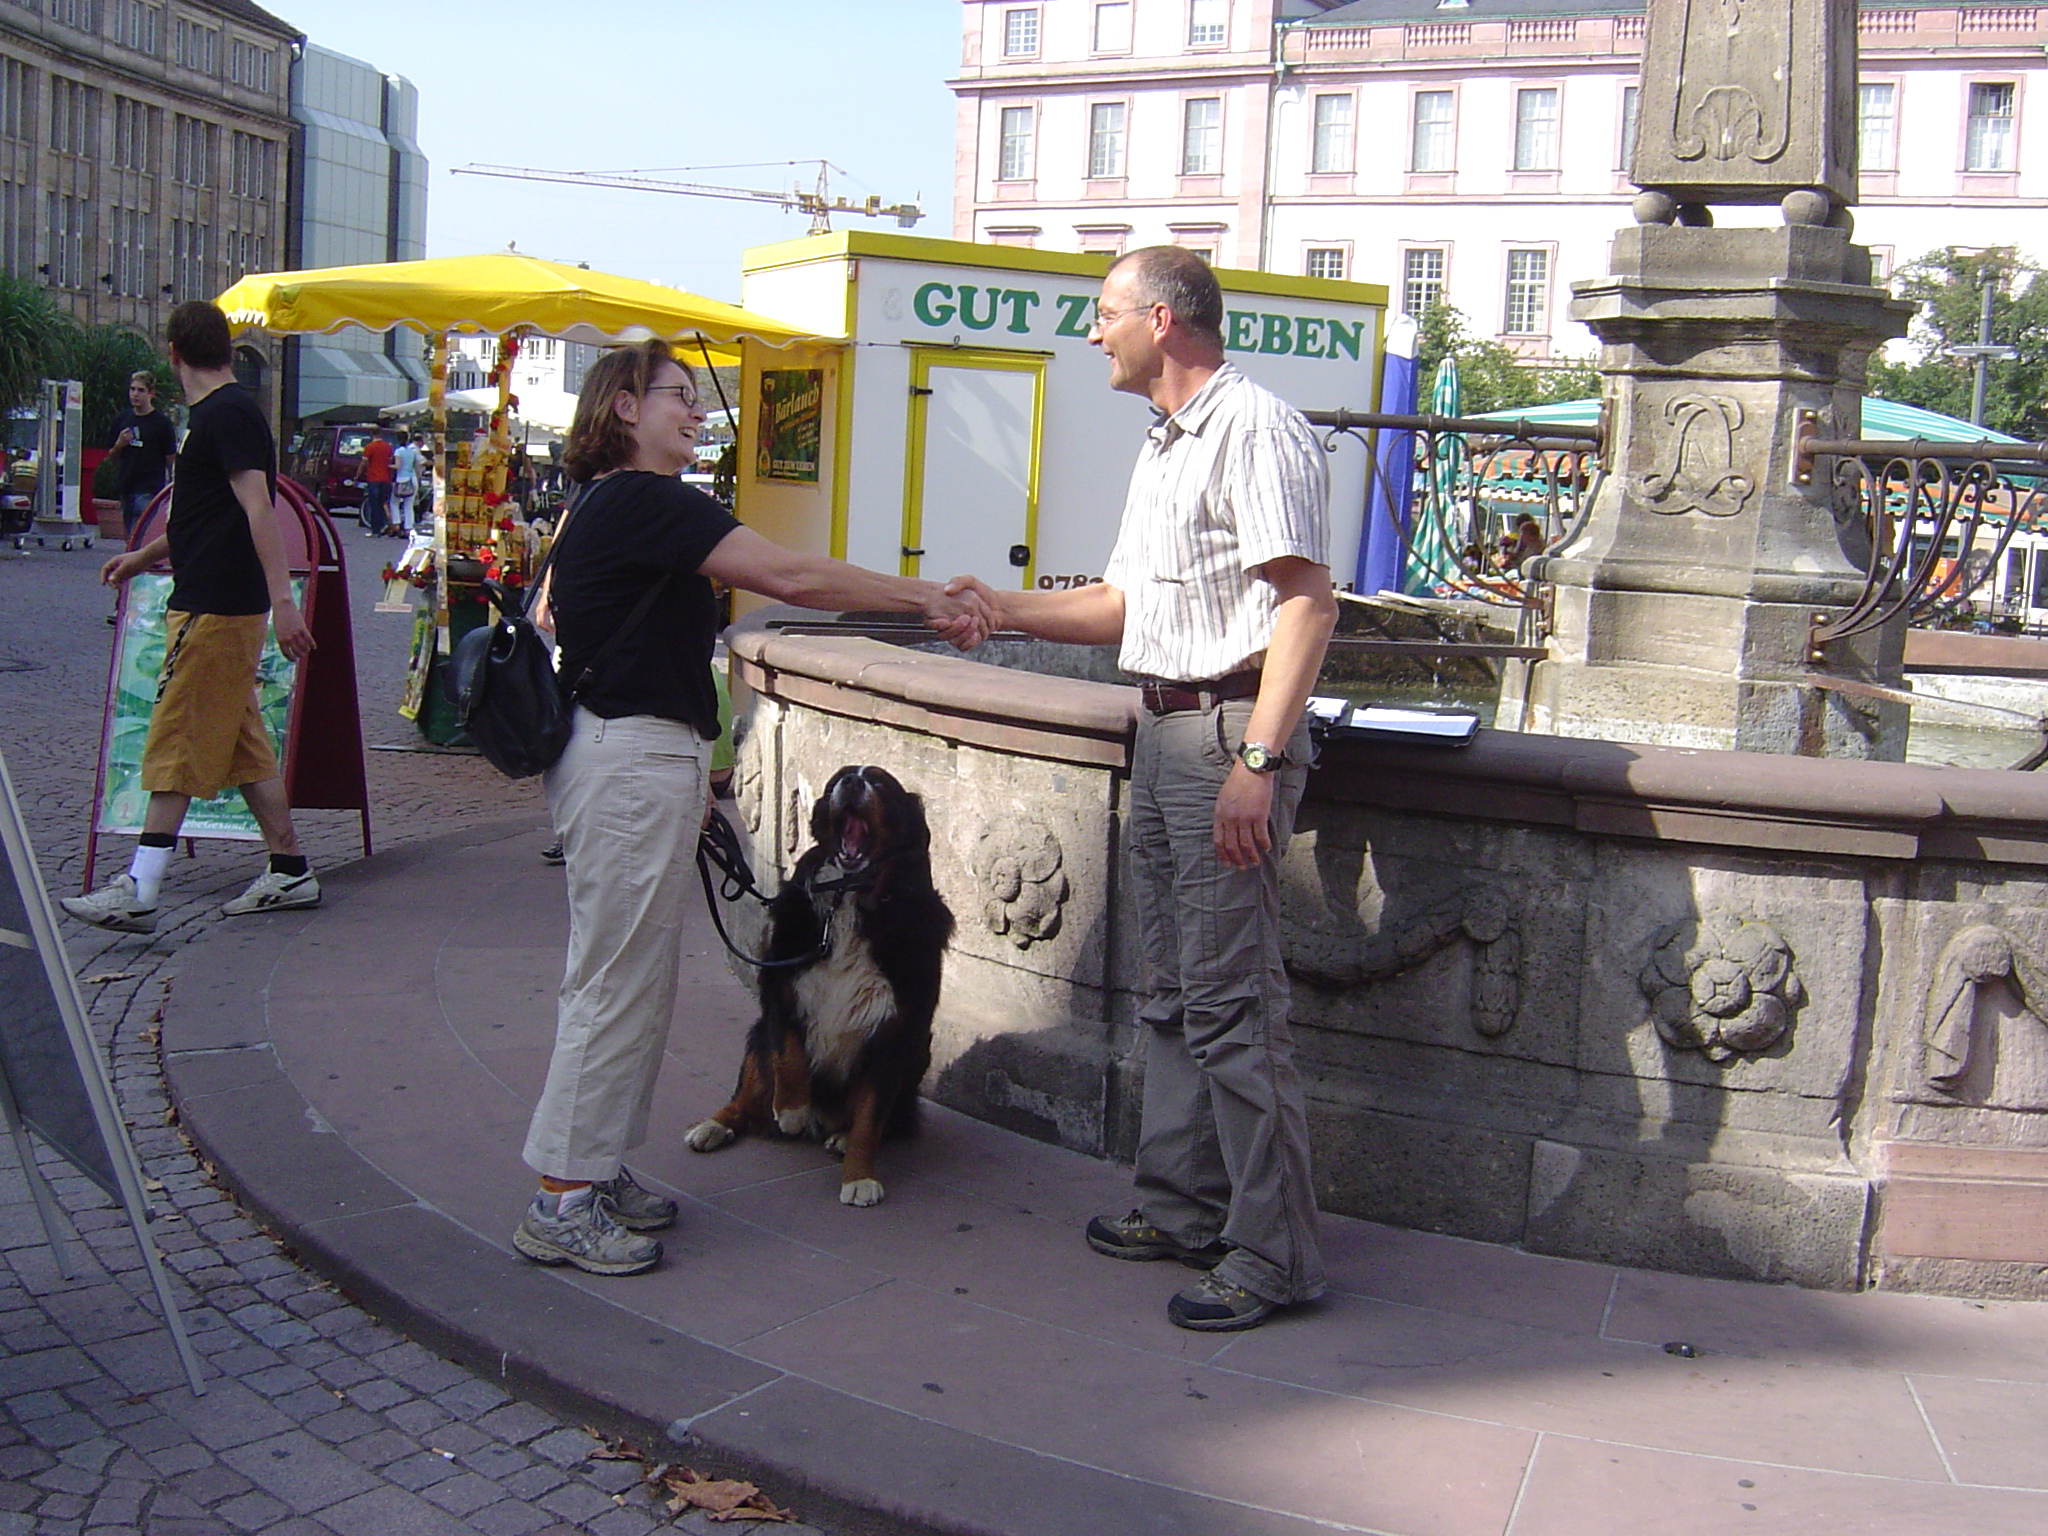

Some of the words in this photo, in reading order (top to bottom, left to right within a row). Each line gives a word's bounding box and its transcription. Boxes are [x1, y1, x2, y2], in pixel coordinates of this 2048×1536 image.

[913, 281, 1041, 334] GUT
[1055, 293, 1101, 338] Z
[1224, 310, 1366, 361] EBEN
